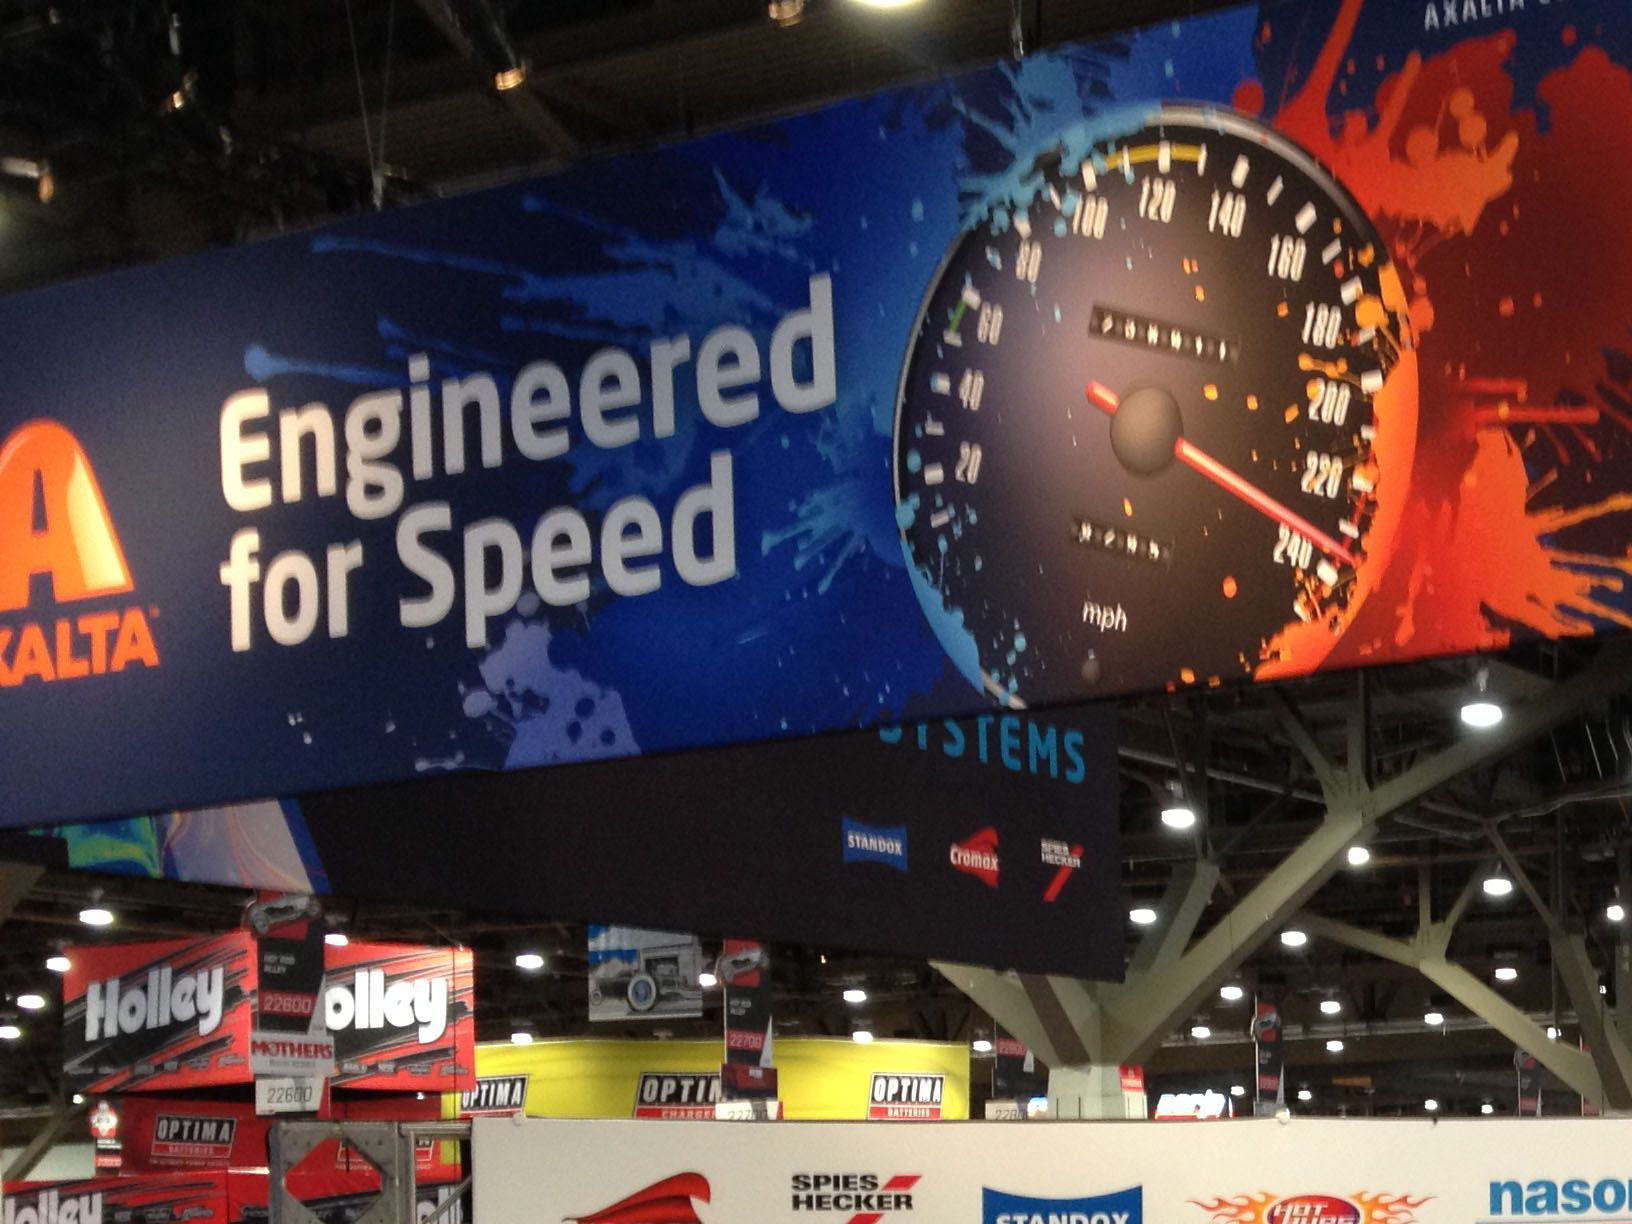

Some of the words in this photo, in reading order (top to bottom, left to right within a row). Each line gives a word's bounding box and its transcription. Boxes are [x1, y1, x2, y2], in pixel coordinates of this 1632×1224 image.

[1073, 195, 1108, 239] 100
[1139, 178, 1177, 223] 120
[1209, 192, 1247, 238] 140
[1015, 240, 1042, 283] 80
[1267, 234, 1307, 281] 160
[976, 303, 1003, 345] 60
[1302, 302, 1342, 348] 180
[219, 273, 838, 520] Engineered
[958, 368, 985, 411] 40
[1308, 378, 1350, 426] 200
[955, 441, 982, 485] 20
[1301, 450, 1343, 498] 220
[219, 527, 363, 652] for
[396, 449, 737, 648] Speed
[1273, 523, 1313, 569] 240
[1082, 600, 1127, 632] mph
[847, 830, 903, 857] STANDOX
[950, 843, 999, 872] Cromax
[1041, 853, 1081, 870] HECKER
[85, 966, 224, 1042] Holley
[325, 967, 448, 1043] olley
[250, 1040, 332, 1060] MOTHERS
[462, 1081, 523, 1109] OPTIMA
[874, 1076, 942, 1103] OPTIMA
[157, 1119, 230, 1142] OPTIMA
[791, 1174, 880, 1192] SPIES
[791, 1194, 914, 1212] HECKER
[1273, 1202, 1328, 1217] HOT
